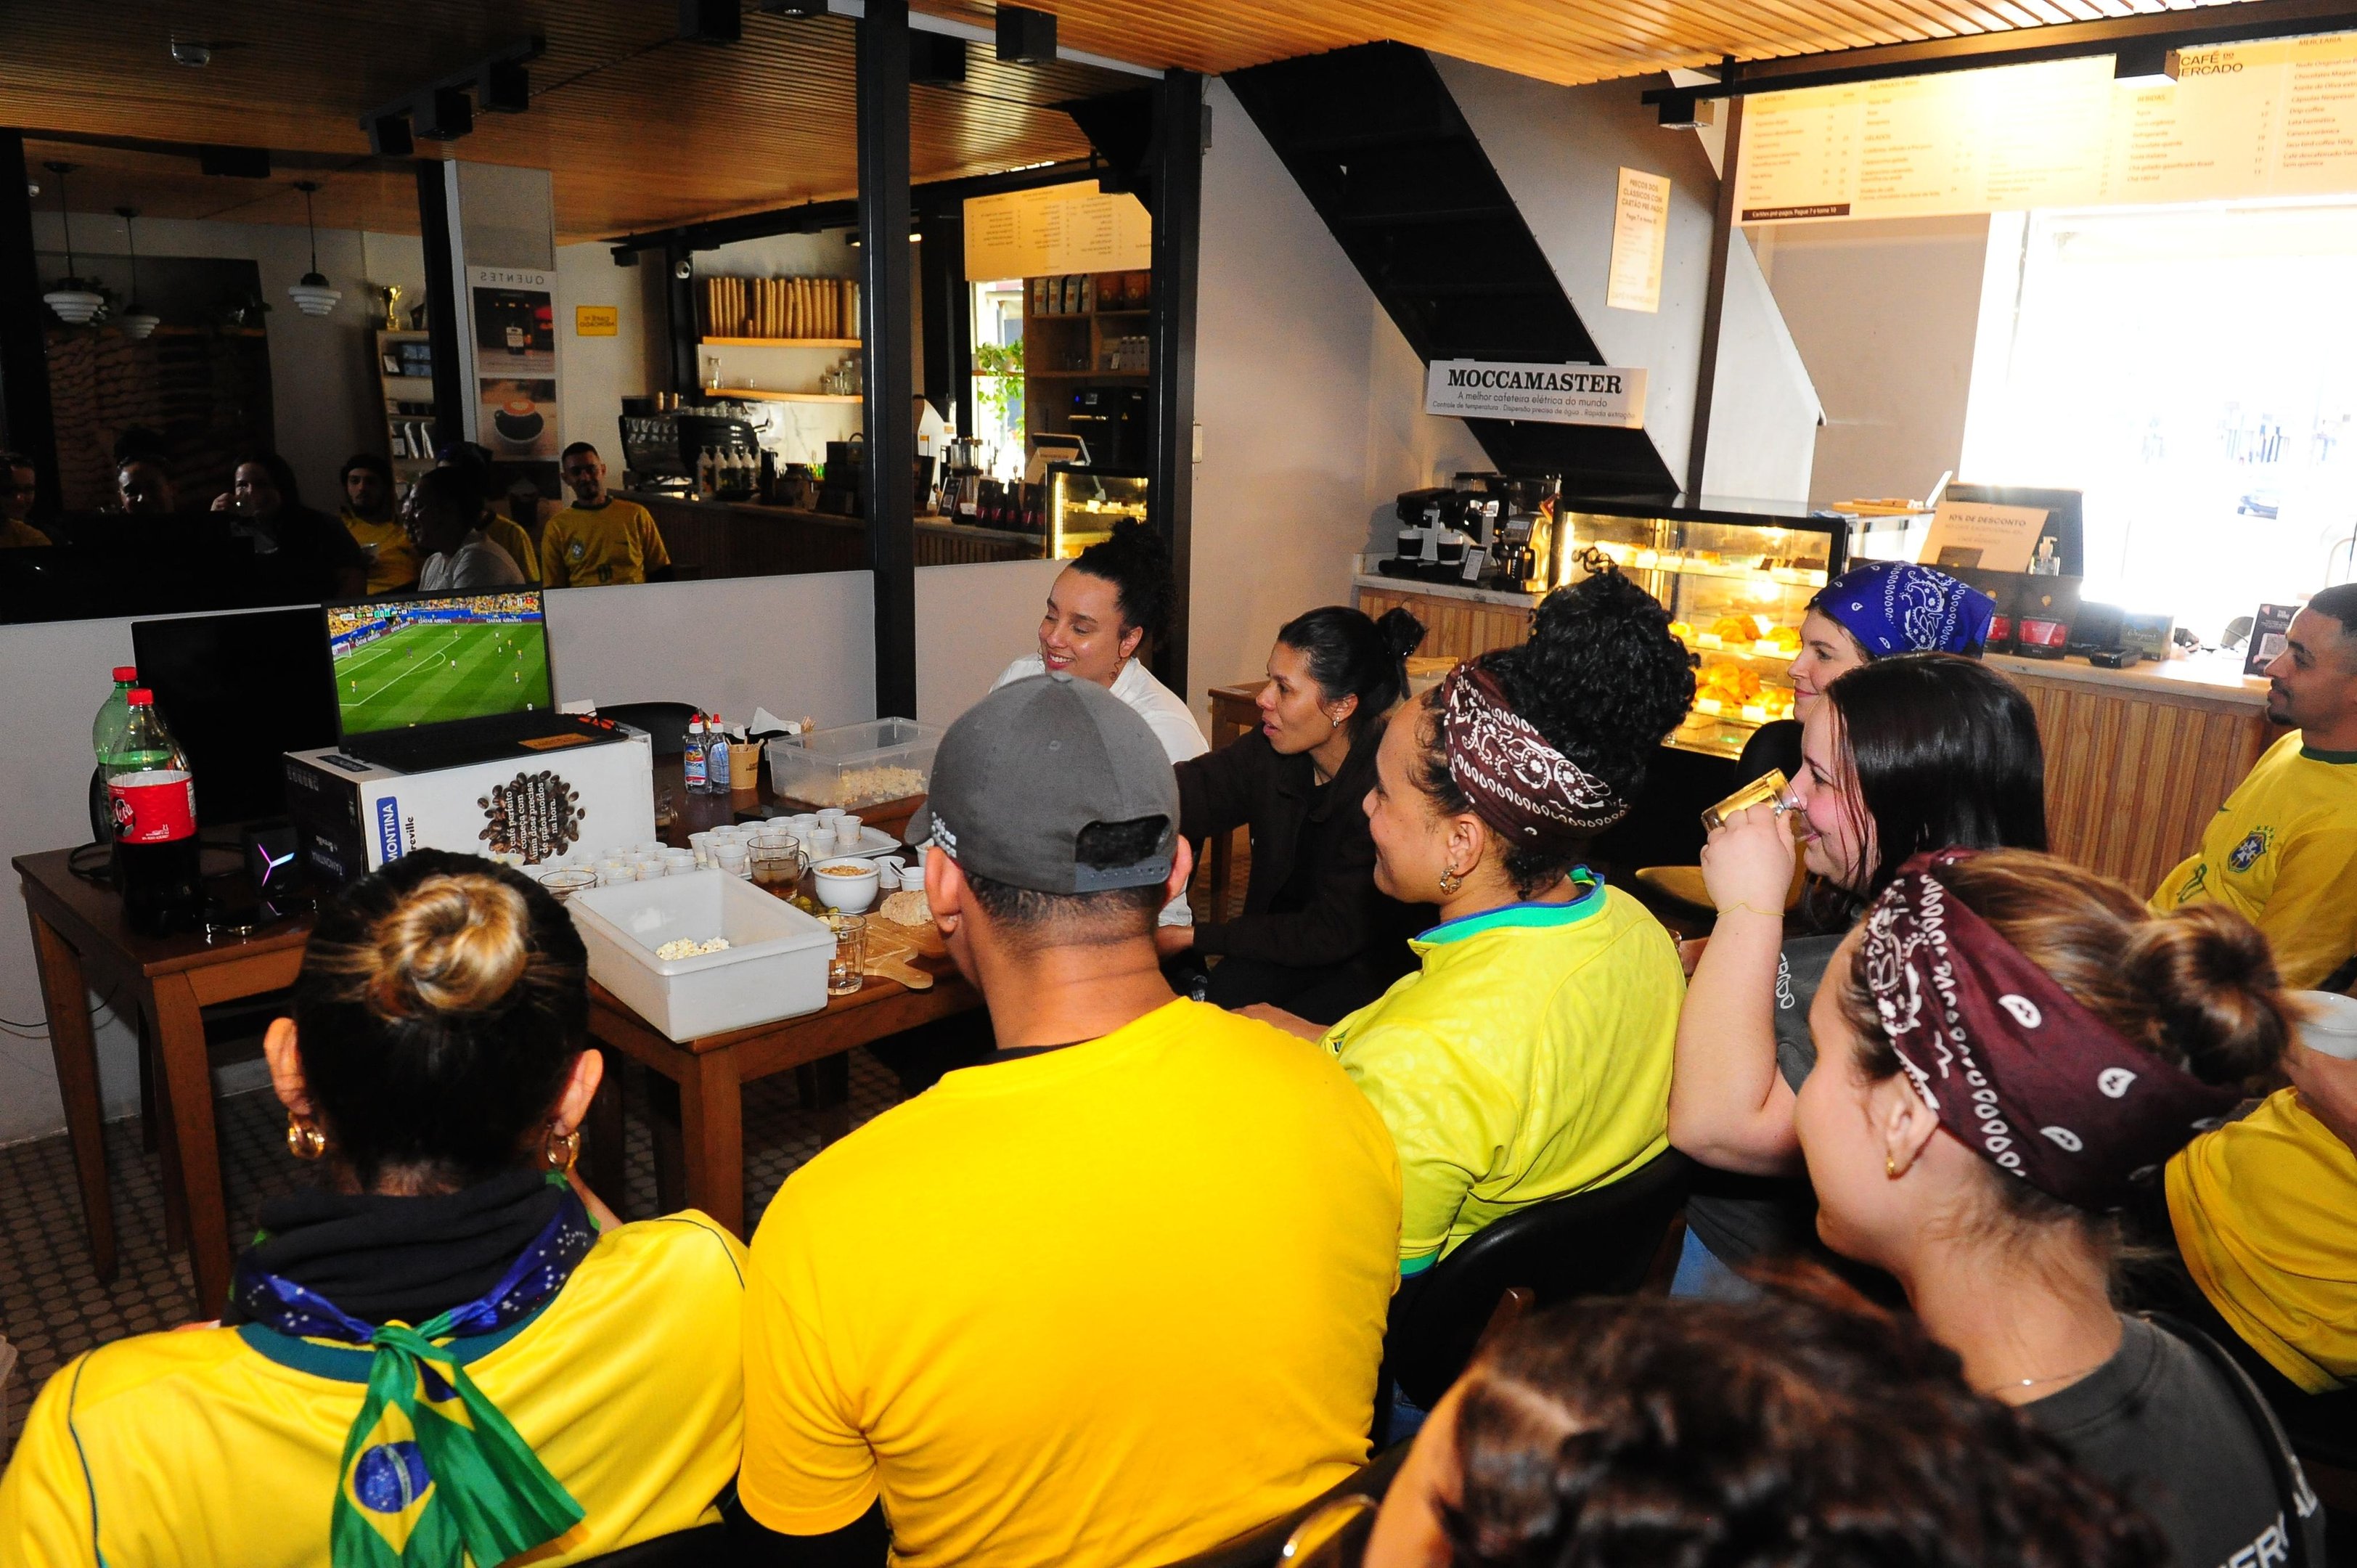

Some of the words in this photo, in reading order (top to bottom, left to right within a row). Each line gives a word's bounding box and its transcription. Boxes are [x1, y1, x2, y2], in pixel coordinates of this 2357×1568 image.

[2180, 51, 2220, 67] CAFÉ
[2178, 62, 2244, 78] ERCADO
[1447, 369, 1623, 394] MOCCAMASTER
[1456, 401, 1464, 409] de
[1465, 402, 1499, 412] temperatura
[1458, 391, 1464, 399] A
[1466, 392, 1492, 401] melhor
[1493, 393, 1529, 404] cafeteira
[1532, 393, 1563, 405] elétrica
[1565, 396, 1577, 405] do
[1578, 398, 1608, 408] mundo
[1977, 516, 2027, 526] DESCONTO
[505, 791, 518, 826] perfeito
[526, 782, 538, 815] precisa
[536, 783, 547, 817] moídos
[549, 799, 557, 822] hora.
[507, 827, 516, 846] café
[518, 814, 528, 849] começa
[528, 816, 538, 837] dose
[539, 817, 550, 841] grãos
[552, 823, 558, 834] na
[539, 843, 549, 854] de
